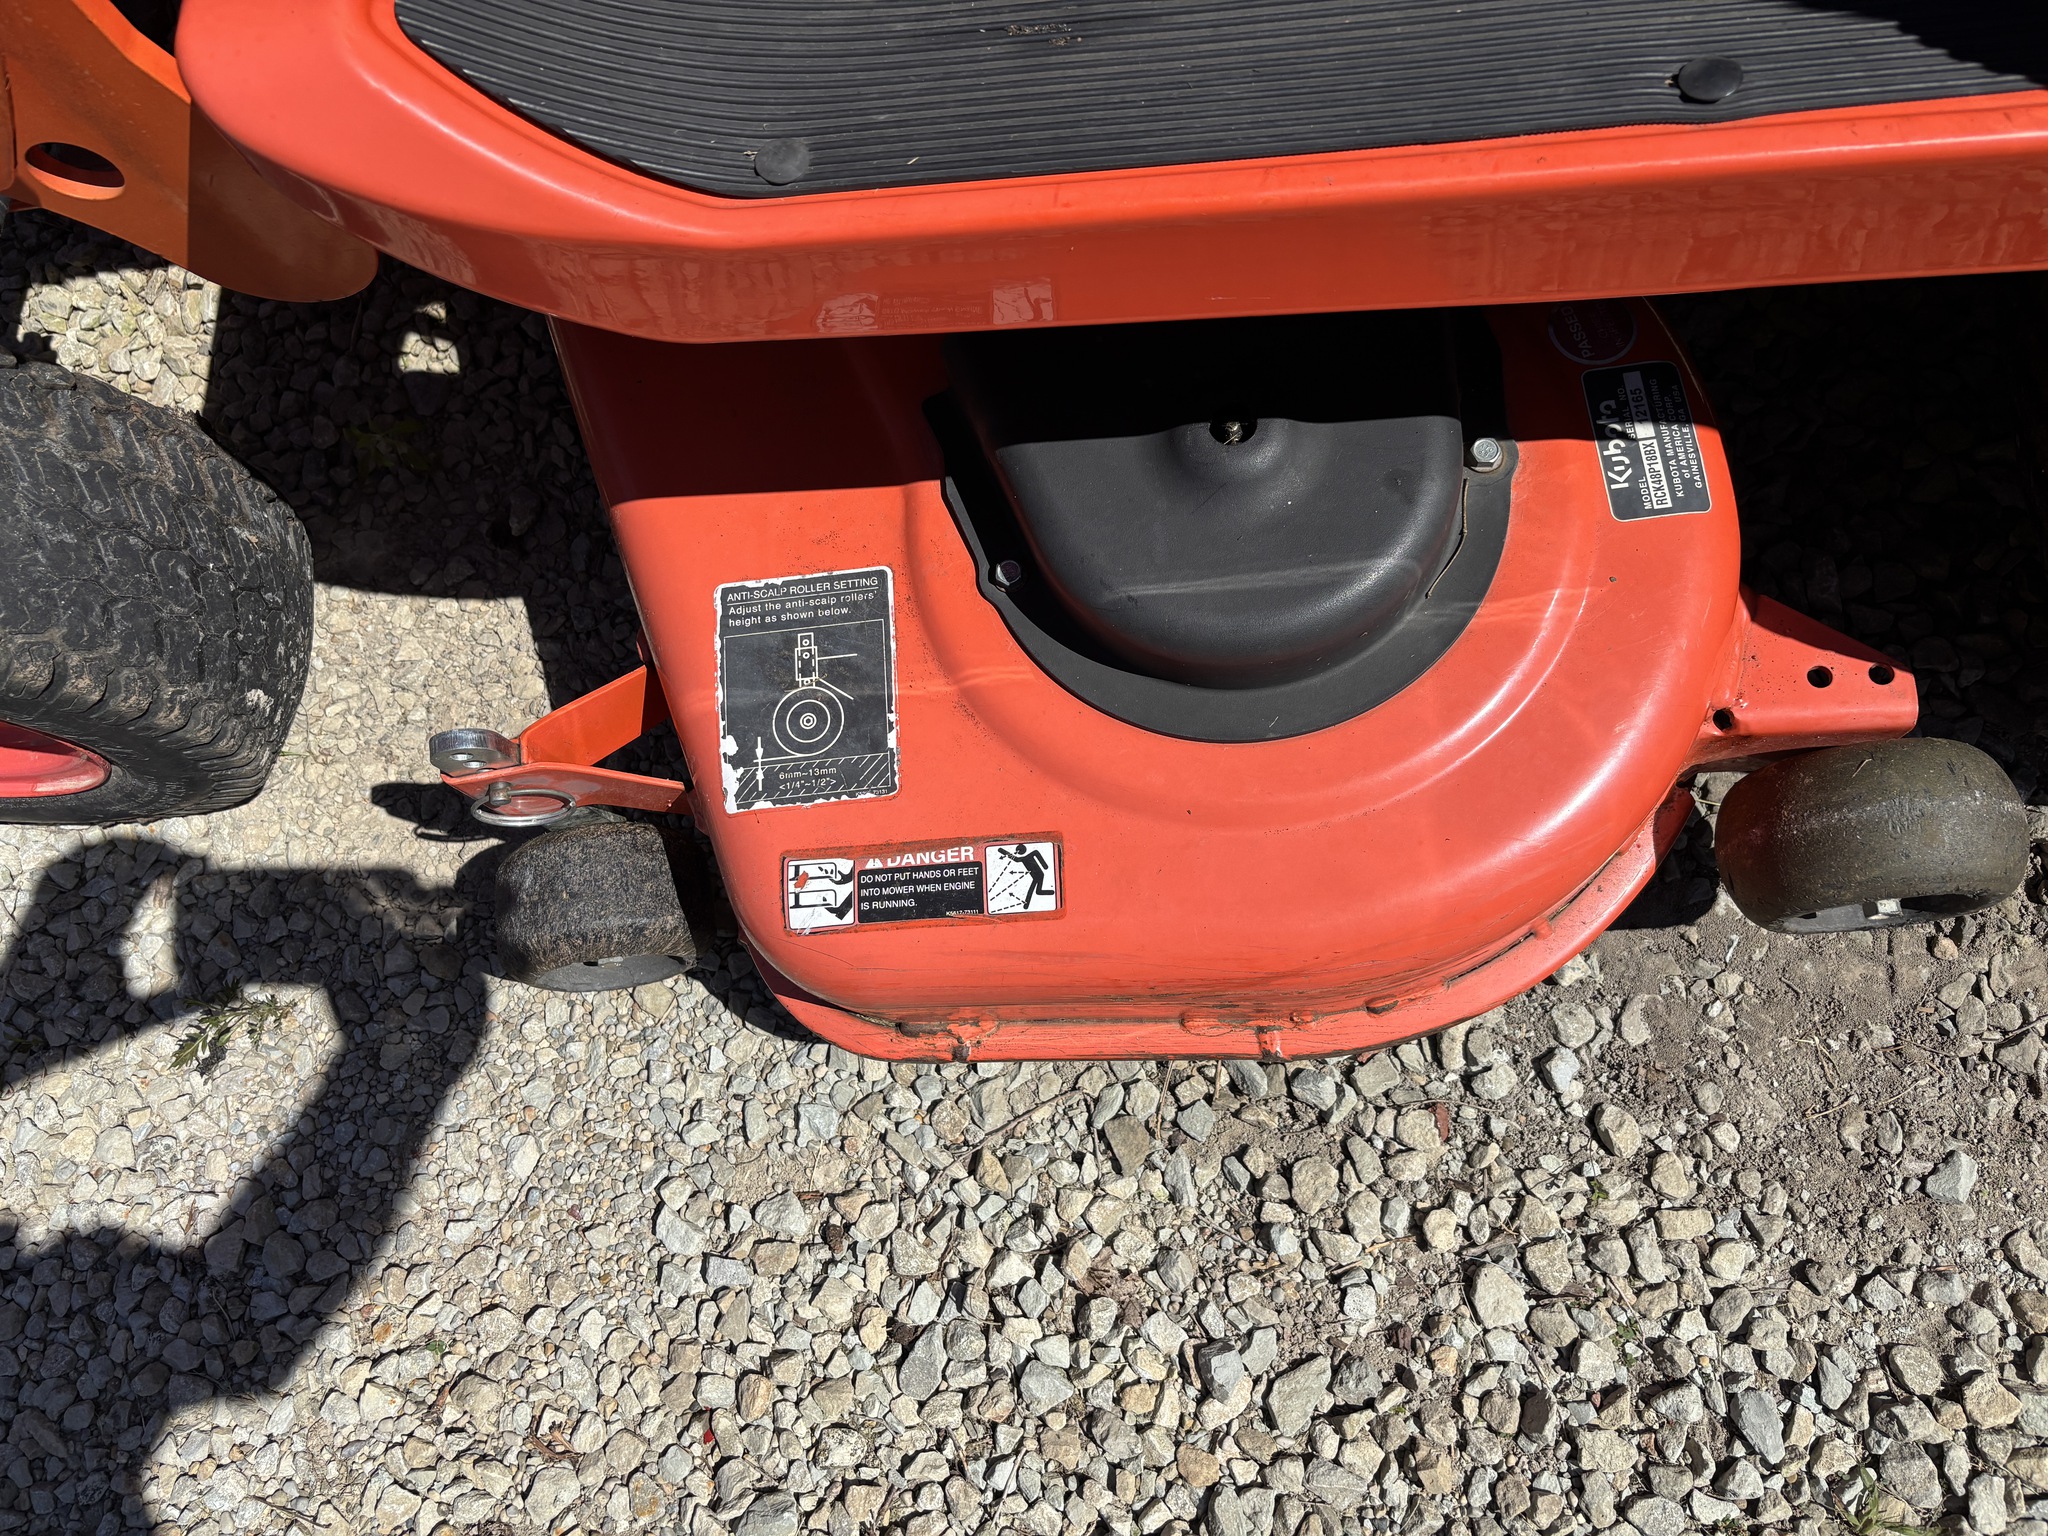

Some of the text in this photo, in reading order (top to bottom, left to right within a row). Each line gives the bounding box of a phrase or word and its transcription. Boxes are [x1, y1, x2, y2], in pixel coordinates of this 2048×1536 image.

[1560, 305, 1596, 358] PASSED
[1617, 384, 1636, 440] SERIAL NO.
[1629, 387, 1650, 426] 12165
[1596, 399, 1633, 489] Kubota
[1648, 378, 1685, 498] KUBOTA MANUFACTURING
[1664, 394, 1691, 479] of AMERICA CORP.
[1671, 384, 1703, 489] GAINESVILLE, GA USA
[1641, 440, 1670, 507] RCK48P18BX
[1638, 476, 1653, 511] MODEL
[727, 576, 879, 602] ANTI-SCALP ROLLER SETTING
[728, 604, 762, 617] Adjust
[765, 601, 782, 612] the
[785, 596, 837, 610] anti-scalp
[728, 606, 852, 628] height as shown below.
[887, 846, 974, 867] DANGER
[860, 867, 979, 884] DO NOT PUT HANDS OR FEET
[860, 881, 976, 897] INTO MOWER WHEN ENGINE
[860, 898, 918, 910] IS RUNNING.
